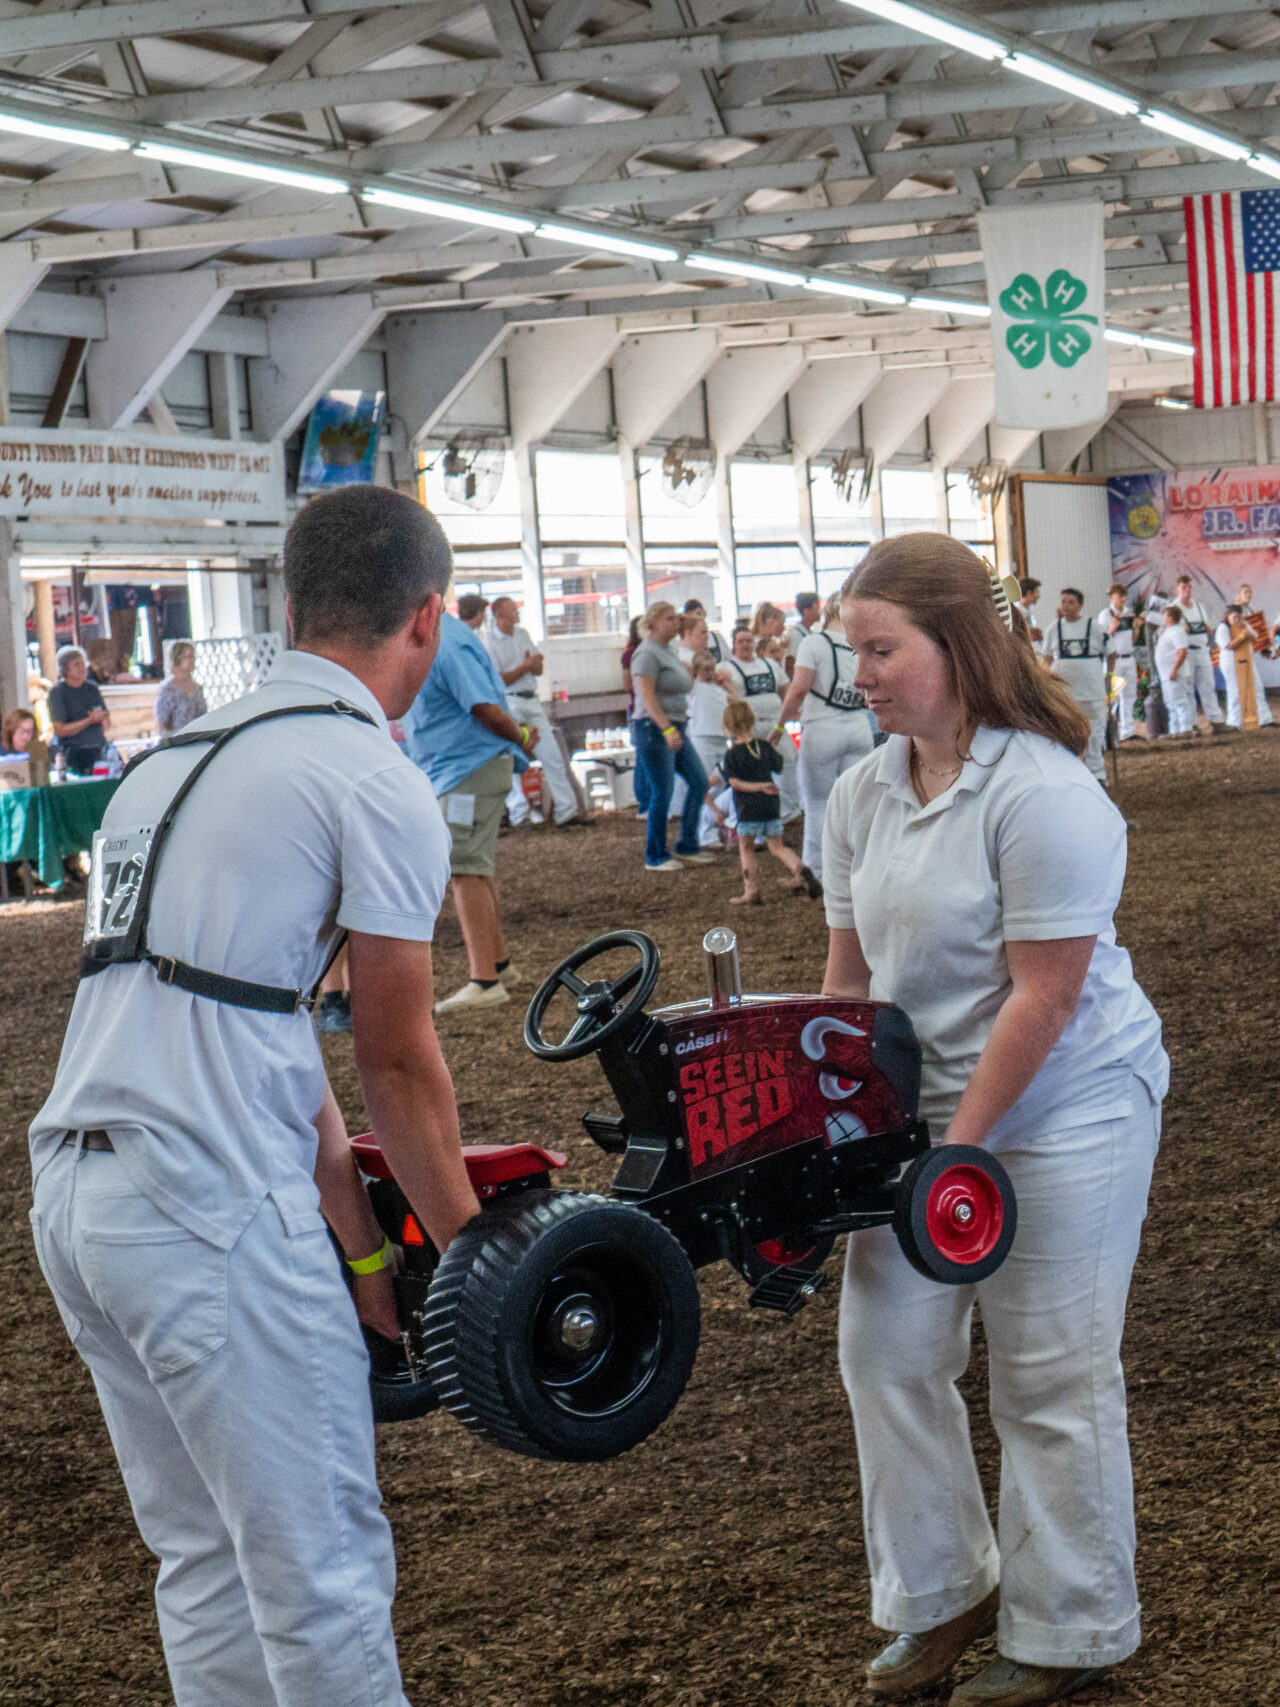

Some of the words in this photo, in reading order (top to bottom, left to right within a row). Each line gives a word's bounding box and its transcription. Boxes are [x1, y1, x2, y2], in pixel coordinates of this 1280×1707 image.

[1203, 507, 1248, 537] JR.
[675, 1031, 715, 1055] CASE
[685, 1076, 793, 1168] RED
